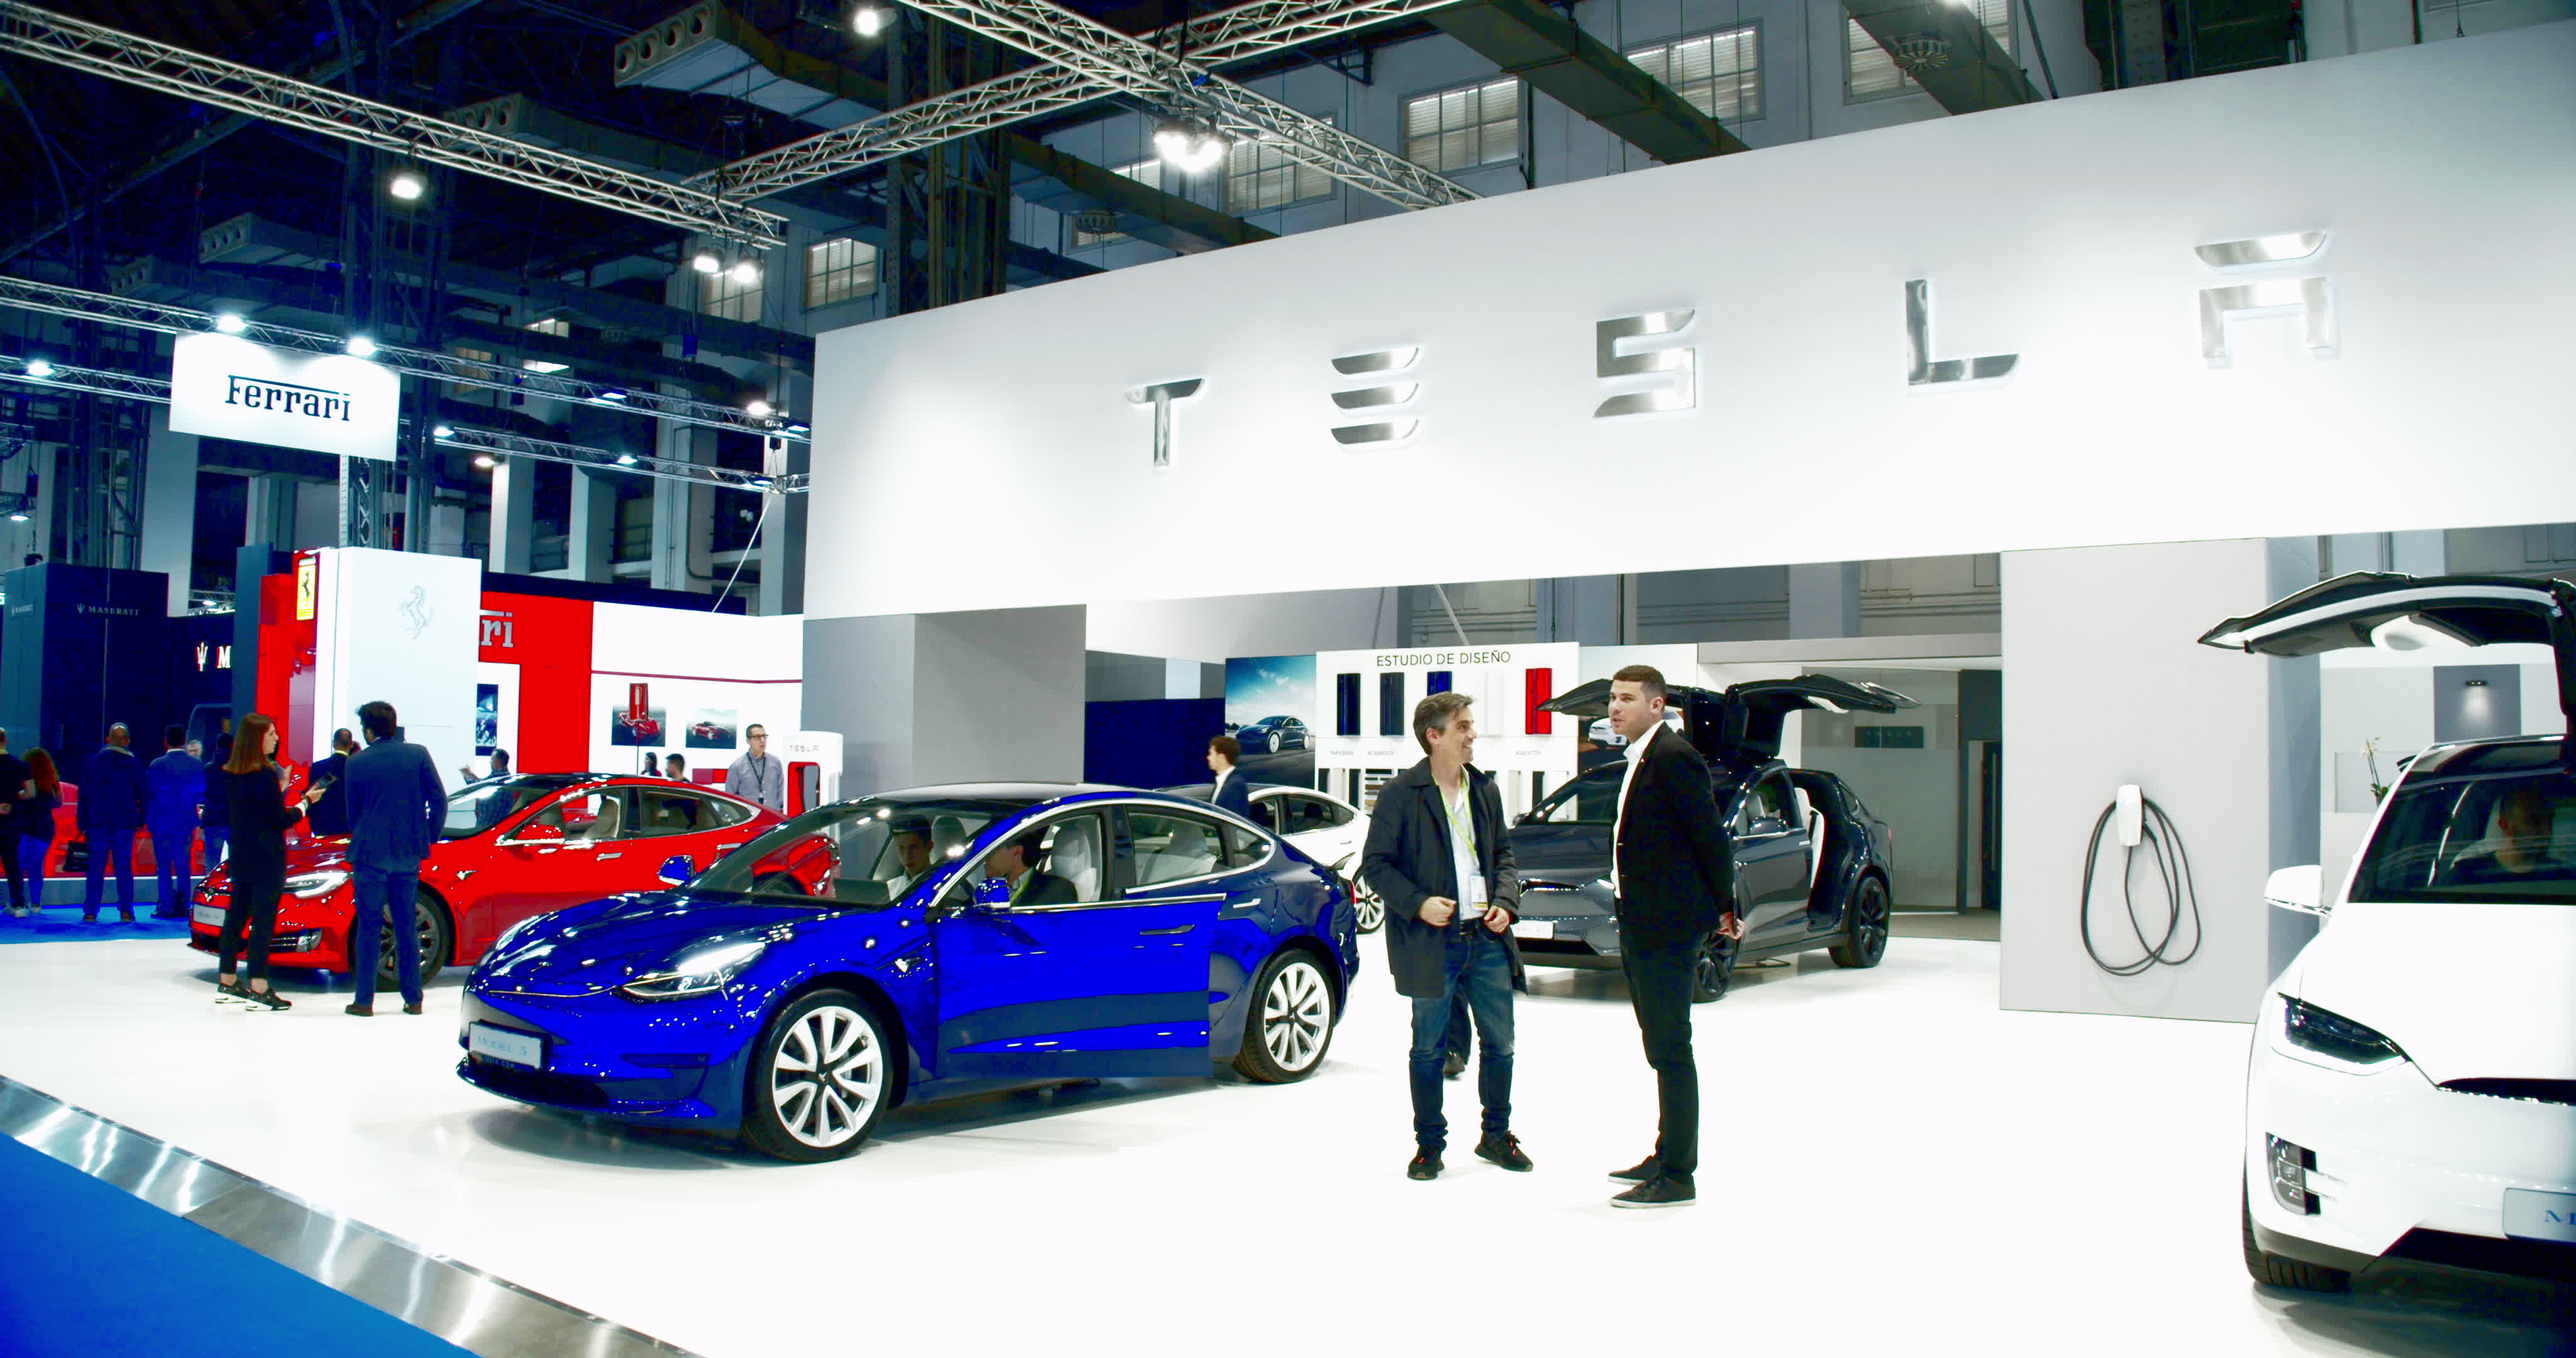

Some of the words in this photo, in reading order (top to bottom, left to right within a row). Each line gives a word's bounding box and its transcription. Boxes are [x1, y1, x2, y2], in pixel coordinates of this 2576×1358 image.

[1126, 231, 2328, 466] TESLA
[225, 374, 351, 422] Ferrari
[88, 605, 140, 616] MASERATI
[1377, 654, 1433, 666] ESTUDIO
[1436, 653, 1454, 665] DE
[1460, 650, 1511, 664] DISEÑO
[789, 744, 820, 753] TESLA
